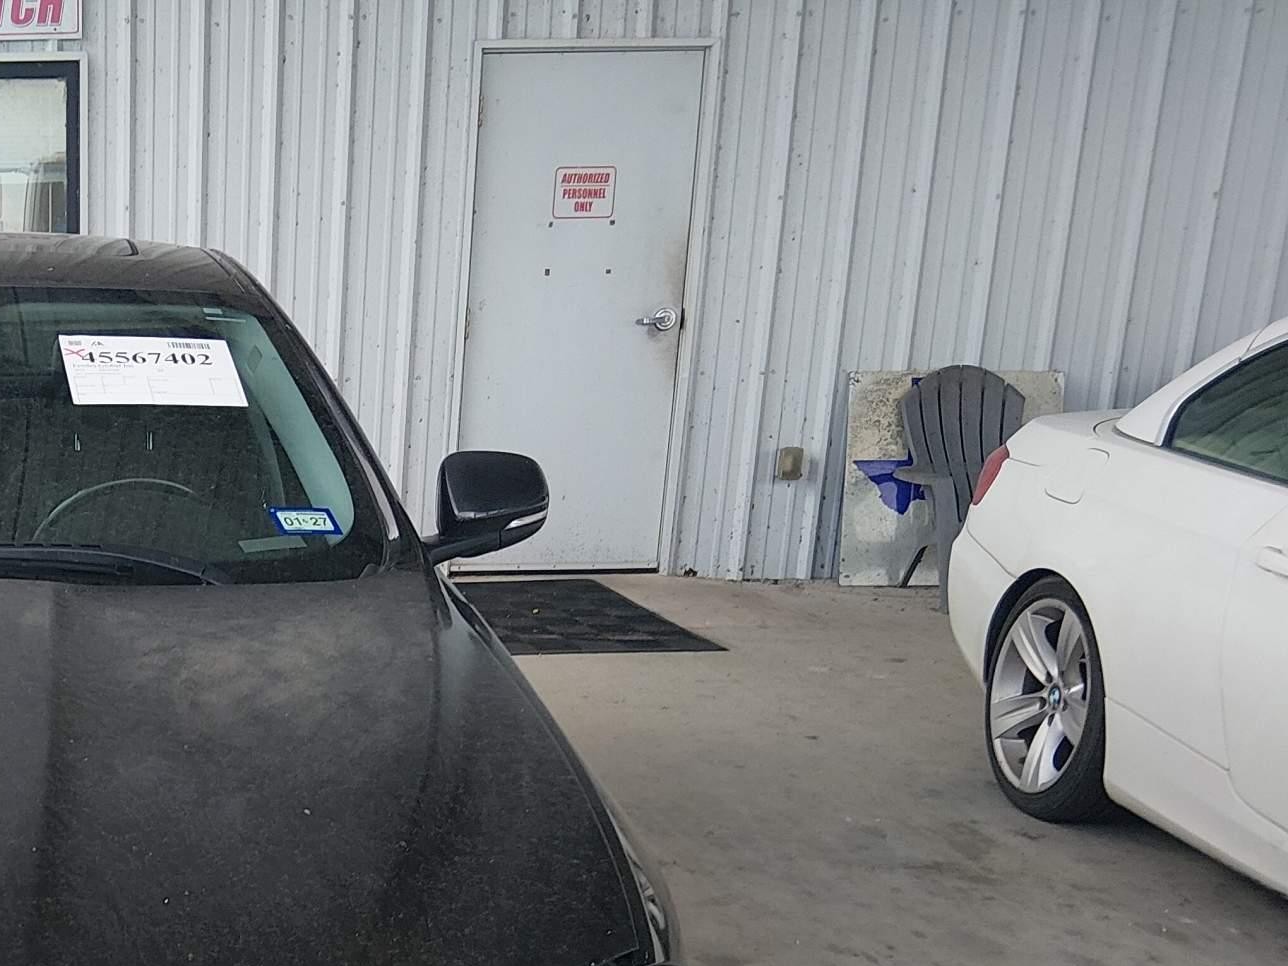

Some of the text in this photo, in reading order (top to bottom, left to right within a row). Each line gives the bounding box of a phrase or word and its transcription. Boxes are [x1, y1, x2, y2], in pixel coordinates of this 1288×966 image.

[561, 172, 610, 184] AUTHORIZED
[562, 187, 606, 199] PERSONNEL
[573, 201, 593, 213] ONLY
[81, 351, 213, 366] 45567402
[283, 516, 327, 527] 01 27
